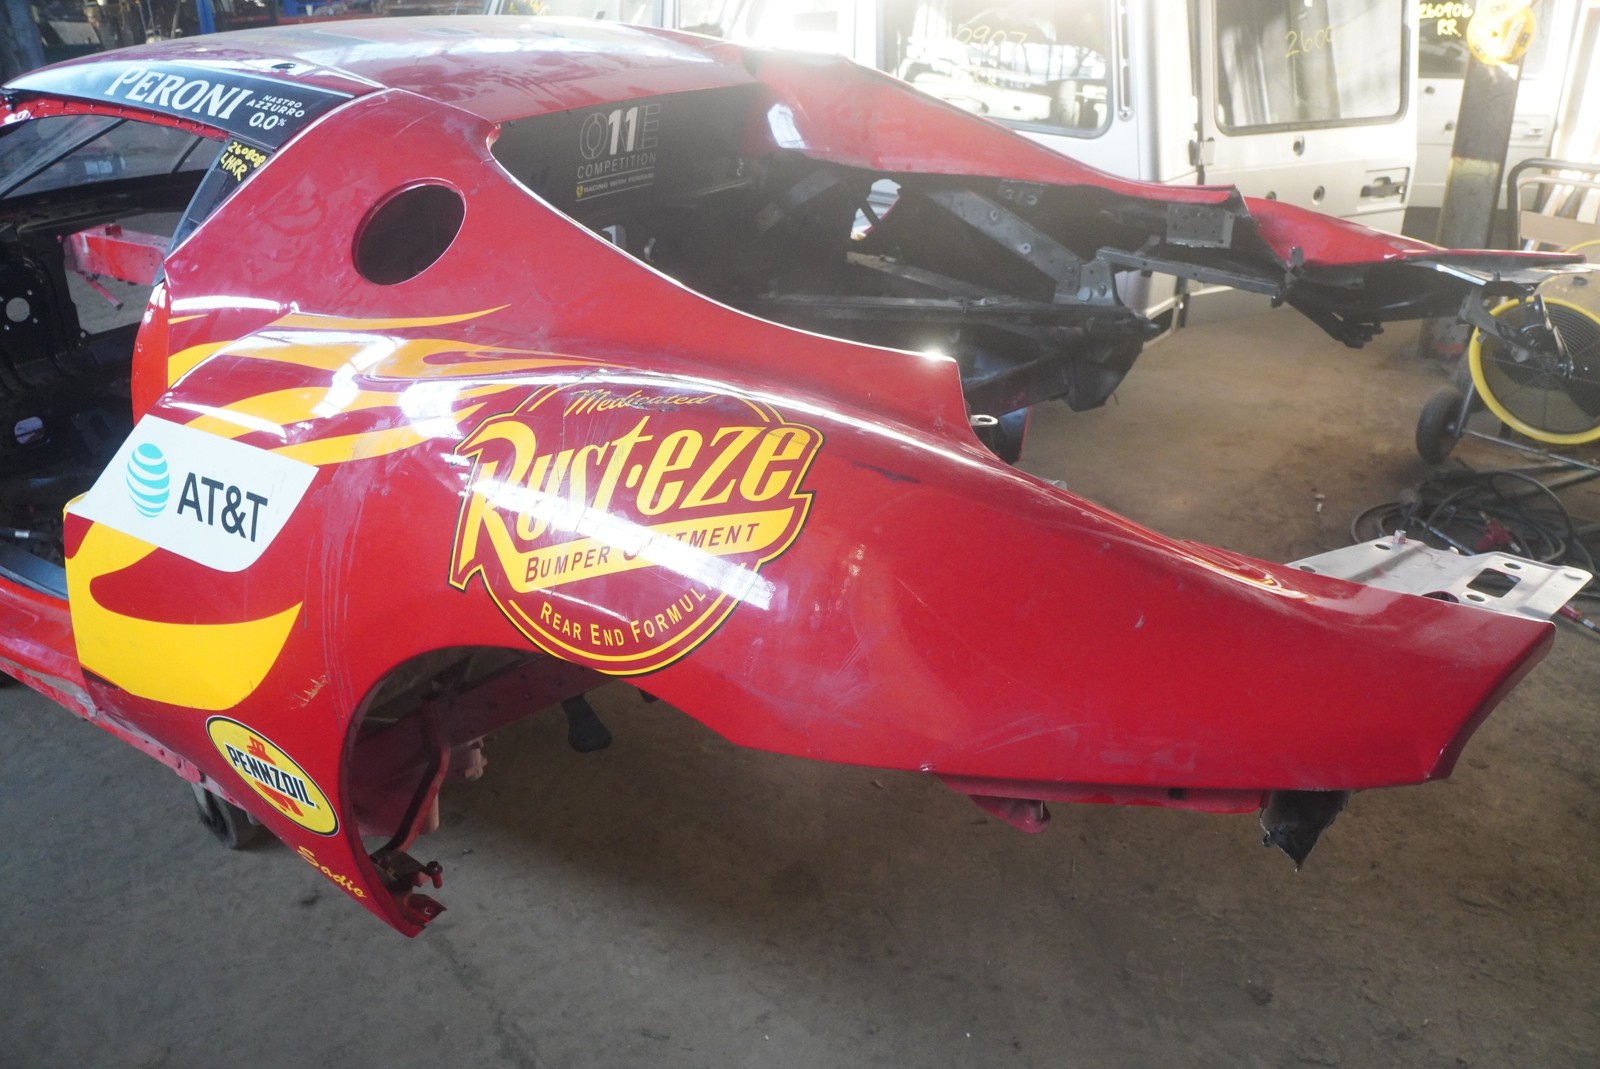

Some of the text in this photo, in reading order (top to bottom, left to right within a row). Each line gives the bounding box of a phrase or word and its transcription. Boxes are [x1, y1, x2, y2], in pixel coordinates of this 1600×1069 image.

[104, 66, 253, 120] PERONI
[246, 99, 305, 118] AZZURRO
[262, 95, 303, 108] NASTRO
[249, 112, 287, 130] 0.0%
[577, 151, 657, 179] COMPETITION
[563, 388, 718, 417] Medicated
[177, 472, 268, 542] AT&T
[525, 545, 610, 583] BUMPER
[540, 584, 714, 647] REAR END FORMUL
[225, 743, 315, 807] PENNZOIL
[297, 845, 368, 898] Sadie
